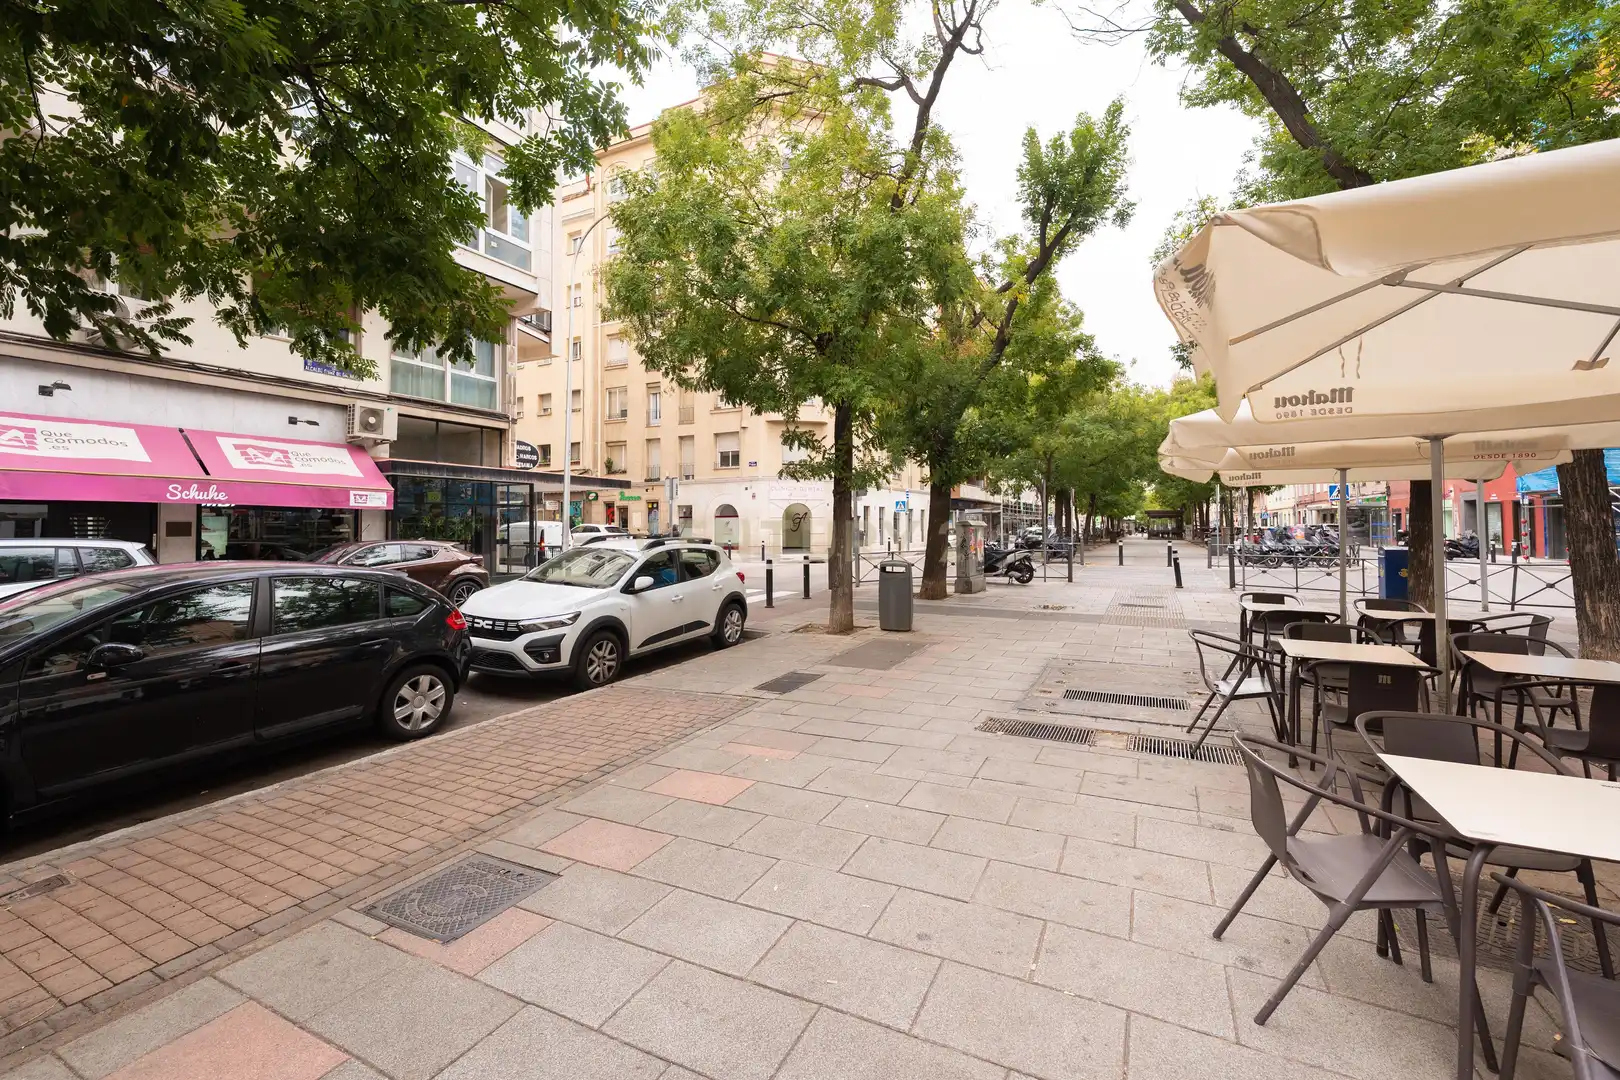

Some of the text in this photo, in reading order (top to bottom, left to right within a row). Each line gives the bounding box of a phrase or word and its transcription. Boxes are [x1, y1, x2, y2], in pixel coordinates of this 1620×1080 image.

[40, 429, 73, 438] Que
[44, 436, 128, 448] comodos
[166, 483, 229, 501] Schuhe
